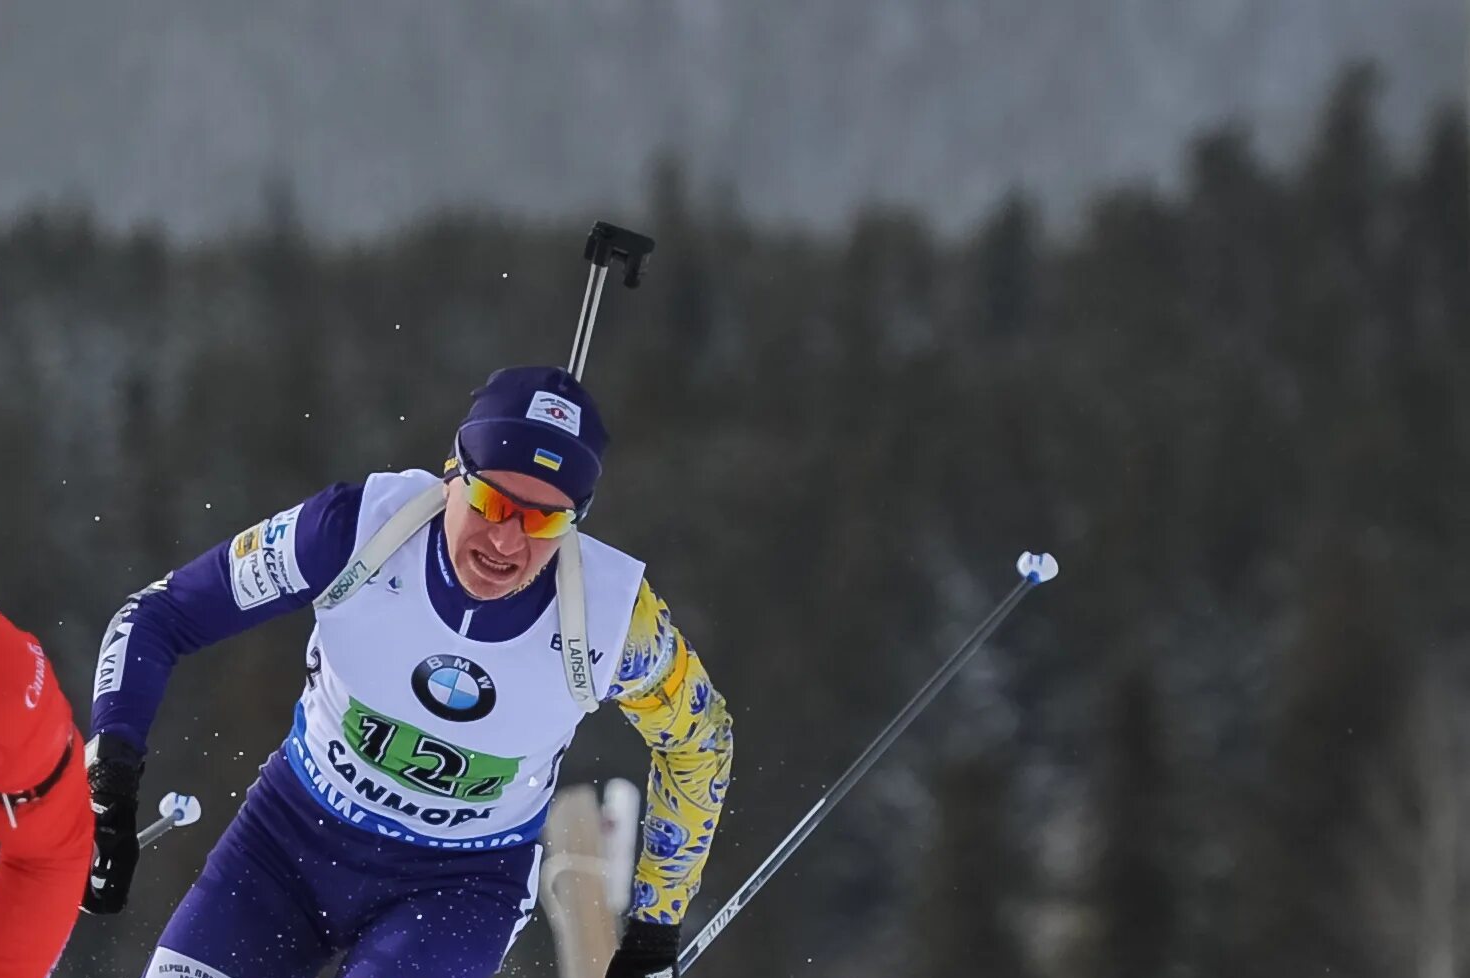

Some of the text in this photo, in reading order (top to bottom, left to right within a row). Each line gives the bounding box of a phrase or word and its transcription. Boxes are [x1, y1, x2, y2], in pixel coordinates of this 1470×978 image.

[550, 633, 604, 665] BW
[567, 638, 588, 689] LARSEN
[426, 655, 493, 690] BMW
